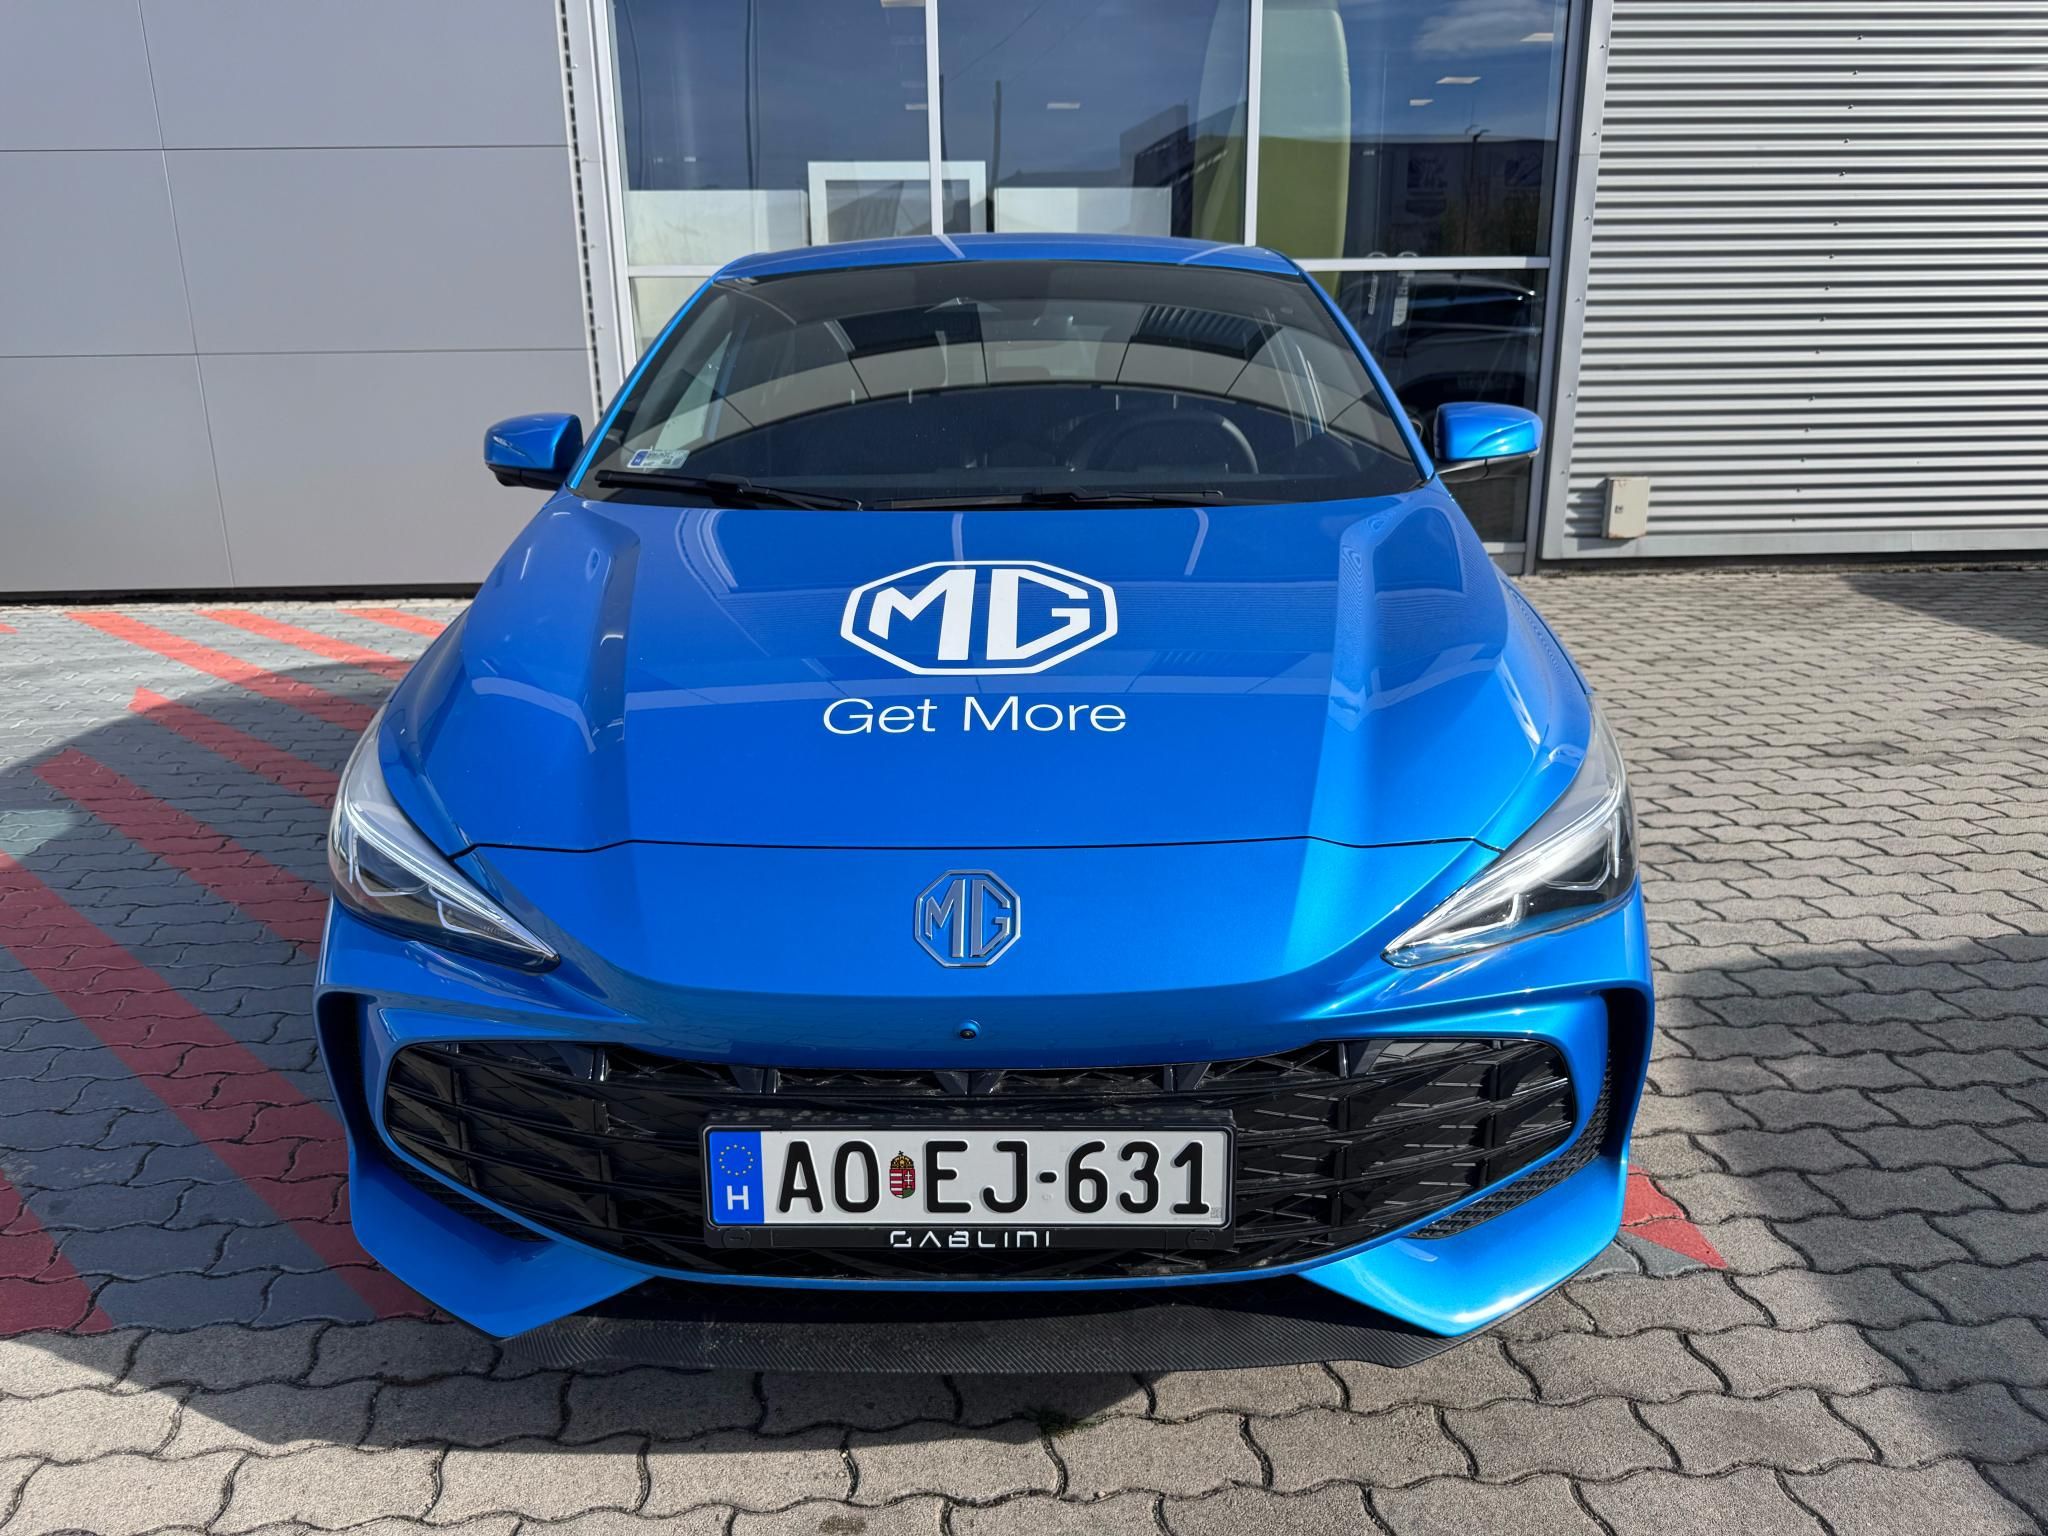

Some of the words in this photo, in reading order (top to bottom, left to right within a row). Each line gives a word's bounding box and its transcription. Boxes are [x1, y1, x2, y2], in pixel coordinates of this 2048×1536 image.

[868, 568, 1091, 661] MG
[823, 698, 938, 735] Get
[963, 695, 1126, 732] More
[924, 878, 1011, 959] MG
[726, 1185, 749, 1210] H
[778, 1140, 880, 1213] AO
[925, 1140, 1210, 1215] EJ-631
[889, 1230, 1051, 1249] GABLINI
